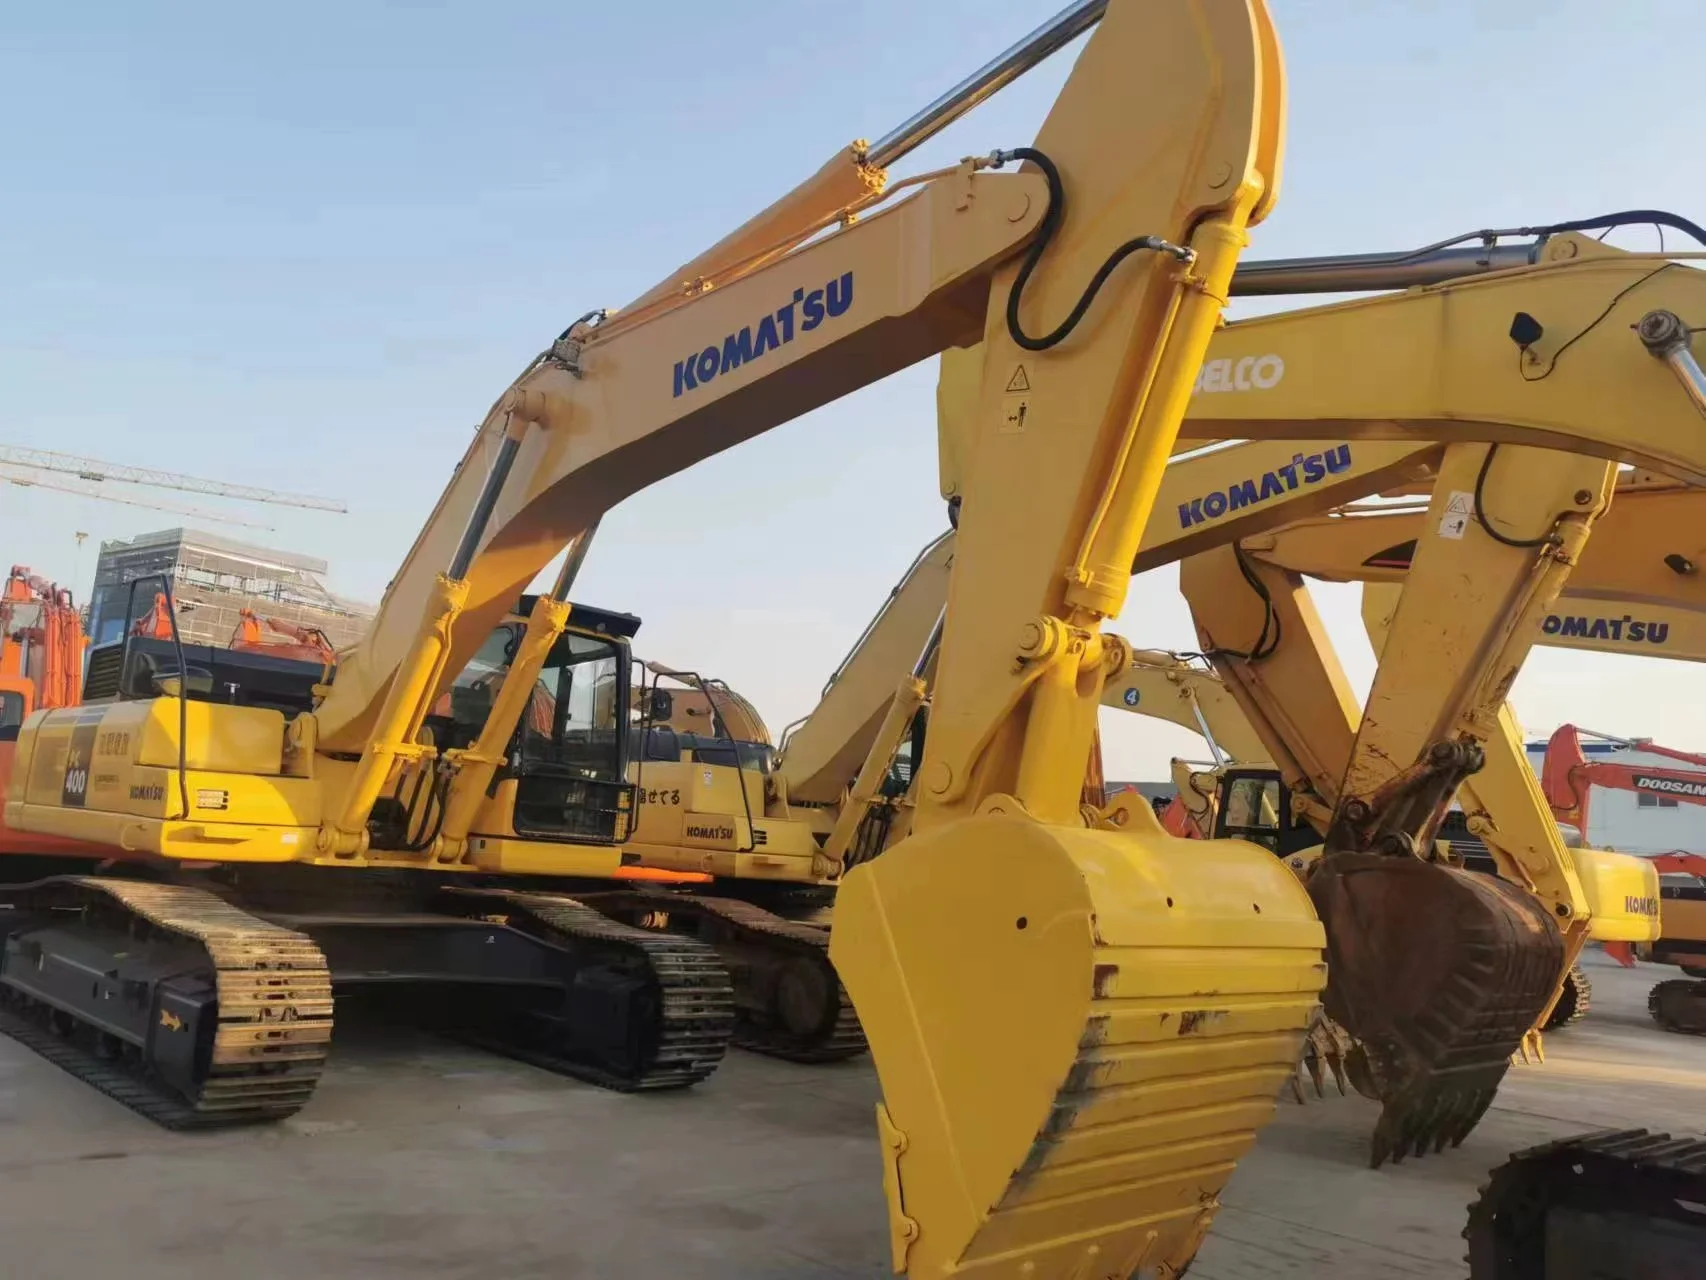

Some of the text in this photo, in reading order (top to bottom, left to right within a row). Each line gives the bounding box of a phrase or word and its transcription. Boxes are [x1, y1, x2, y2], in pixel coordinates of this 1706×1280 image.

[673, 271, 853, 398] KOMATSU
[1178, 444, 1351, 529] KOMATSU
[1541, 614, 1669, 644] OMATSU
[1127, 690, 1137, 705] 4
[66, 769, 85, 793] 400
[687, 826, 733, 839] KOMATSU
